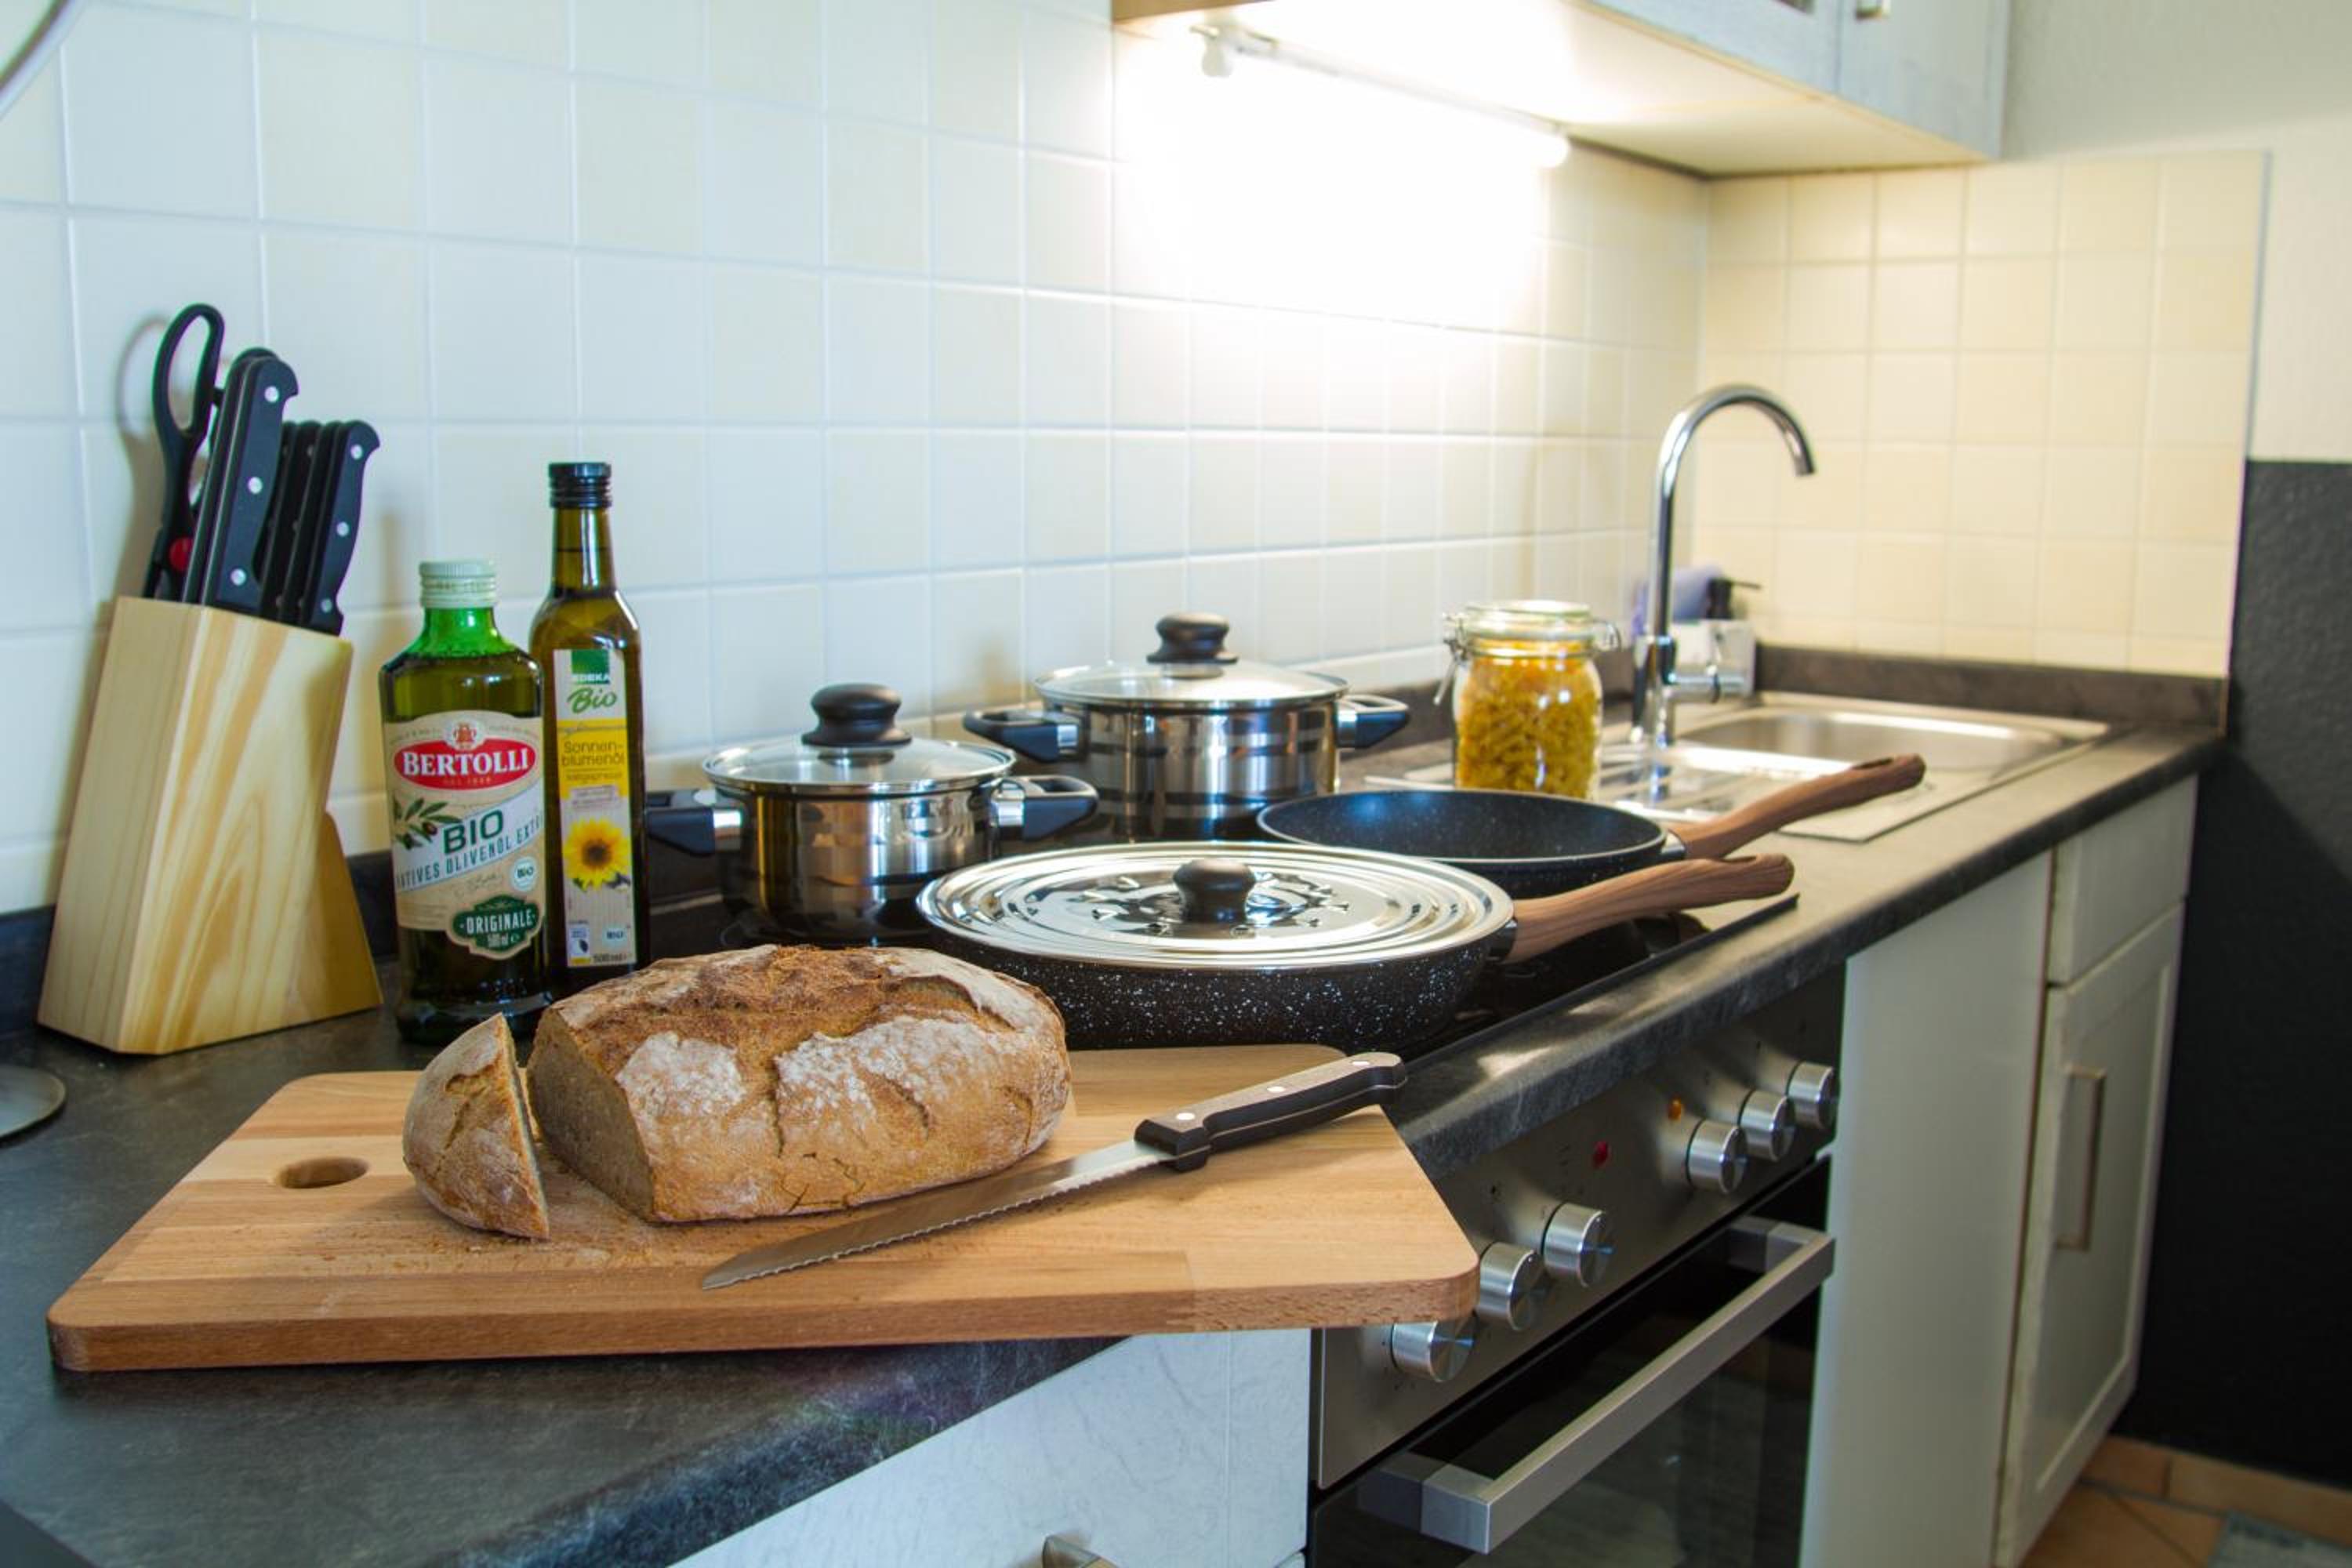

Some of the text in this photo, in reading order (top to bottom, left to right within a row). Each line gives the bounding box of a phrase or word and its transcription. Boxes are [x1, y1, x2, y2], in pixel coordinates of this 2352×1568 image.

[566, 688, 617, 714] Bio
[564, 741, 624, 754] Sonnen-
[402, 747, 528, 776] BERTOLLI
[443, 809, 503, 854] BIO
[466, 909, 533, 934] ORIGINALE
